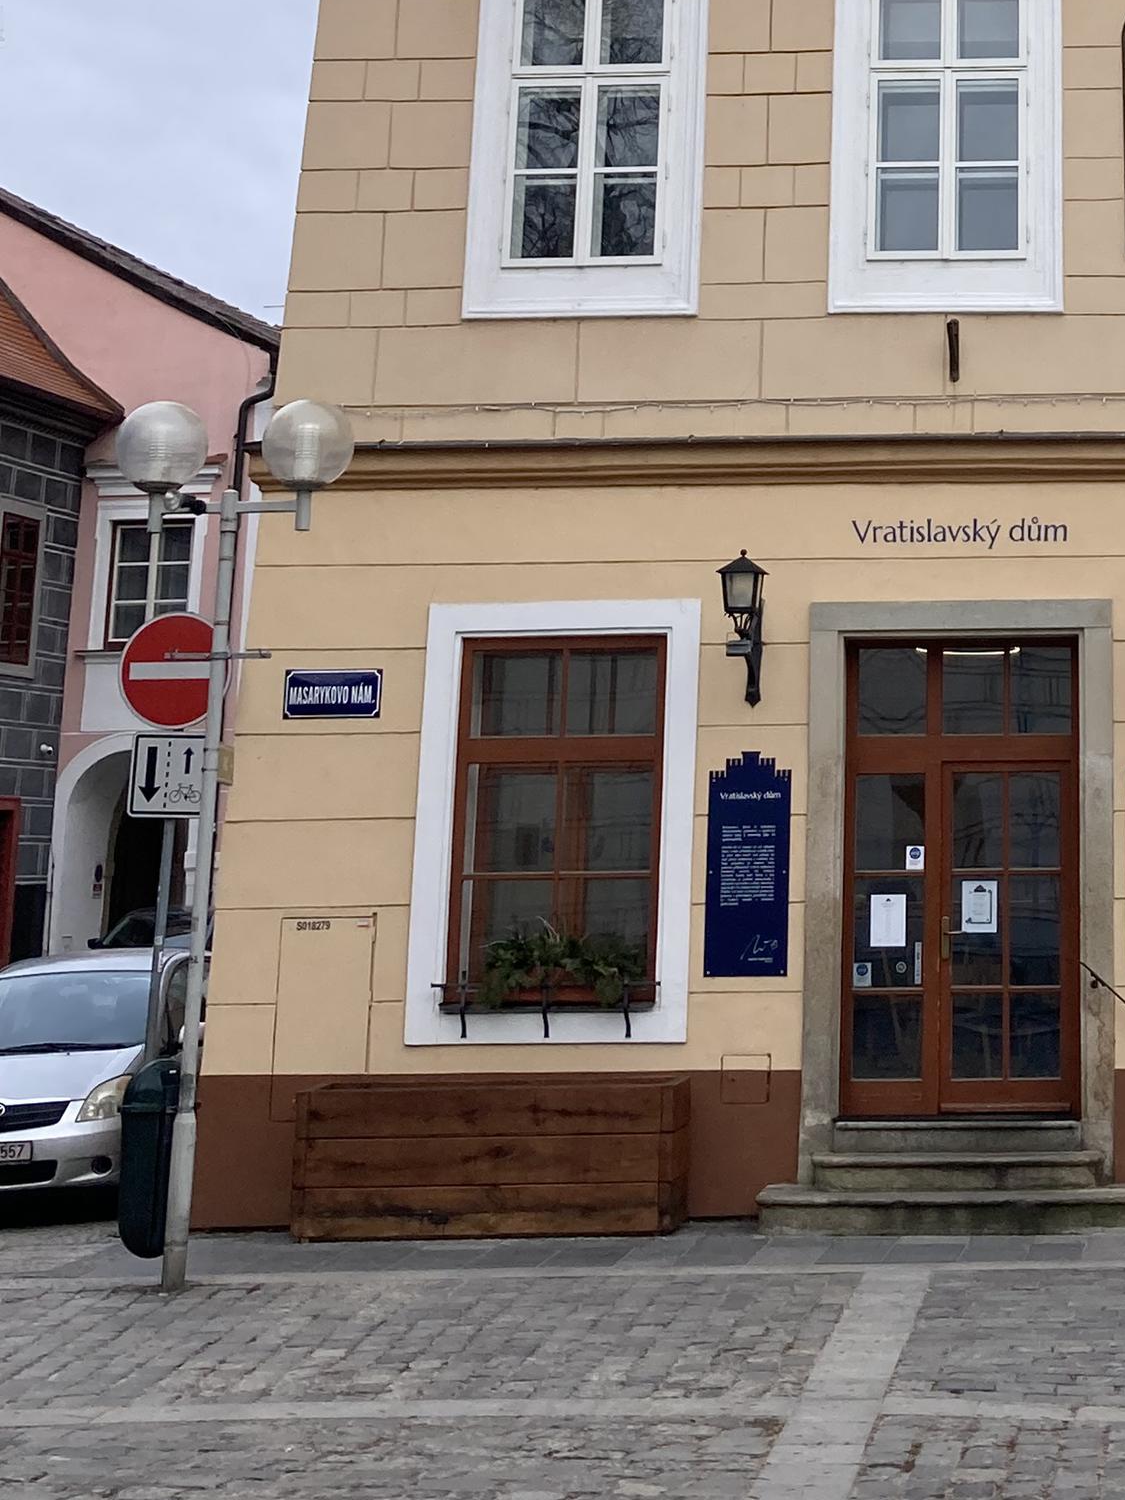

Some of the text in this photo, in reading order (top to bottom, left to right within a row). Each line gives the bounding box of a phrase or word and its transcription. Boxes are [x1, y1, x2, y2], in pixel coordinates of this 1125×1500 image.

[851, 516, 1069, 550] Vratislavský dům
[288, 681, 376, 705] MASARYKOVO NÁM.
[720, 790, 782, 801] Vratislavský dům
